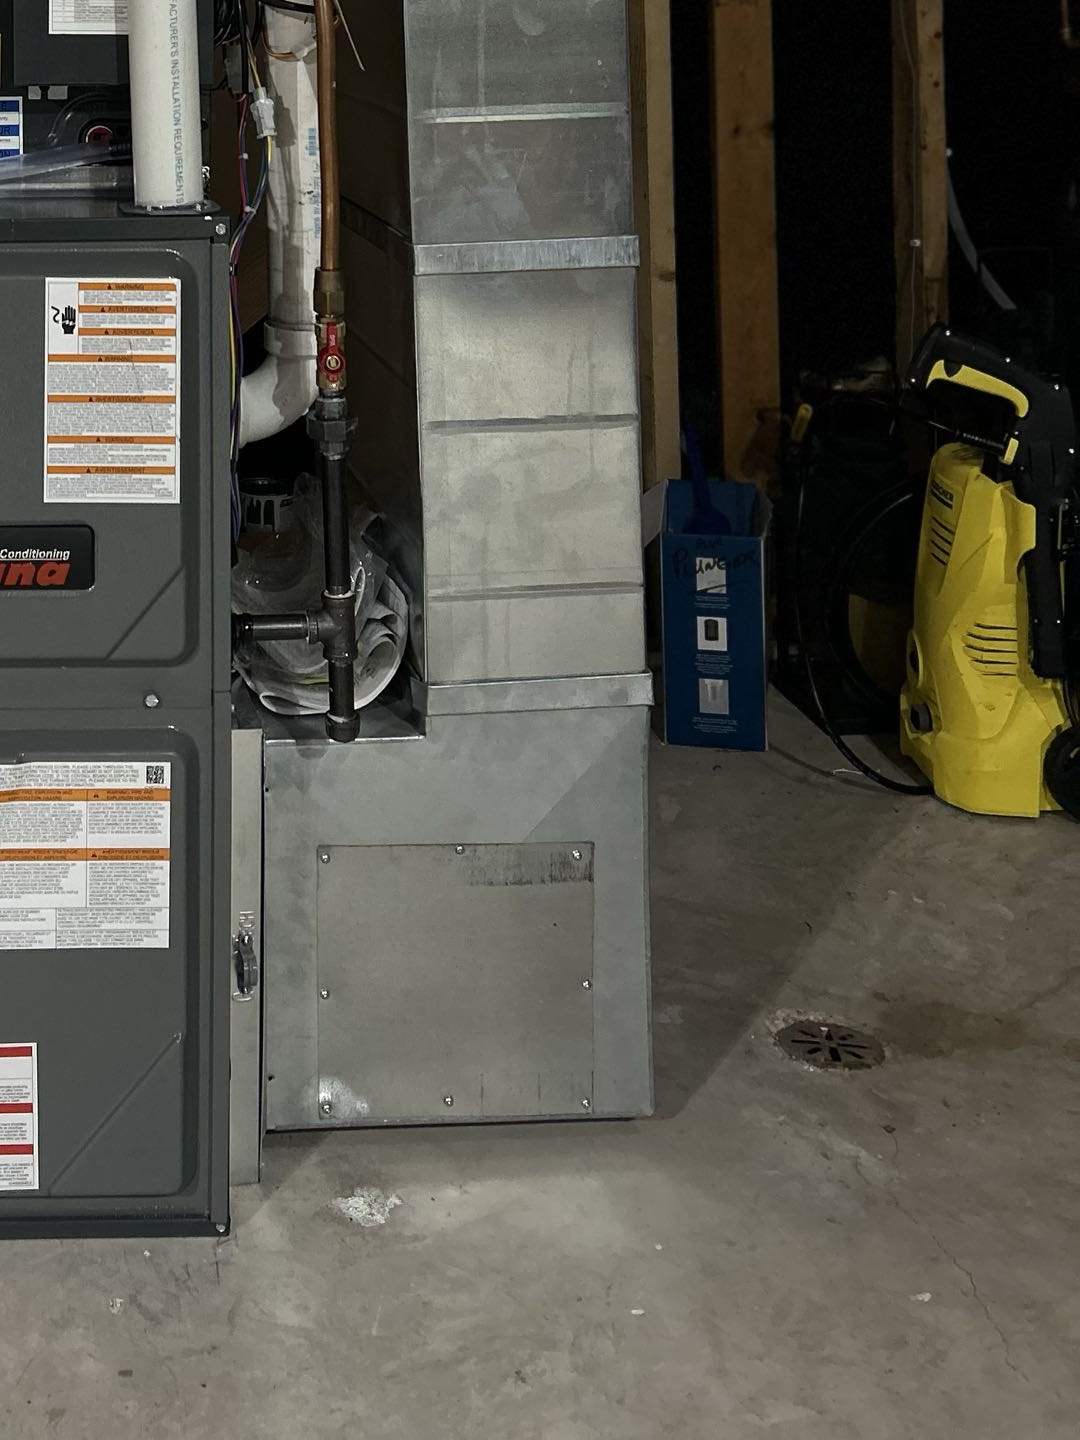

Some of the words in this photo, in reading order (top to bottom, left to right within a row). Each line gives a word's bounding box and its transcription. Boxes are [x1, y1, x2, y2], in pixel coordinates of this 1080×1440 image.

[171, 59, 182, 127] INSTALLATION
[173, 128, 184, 204] REQUIREMENTS
[0, 548, 71, 561] Conditioning
